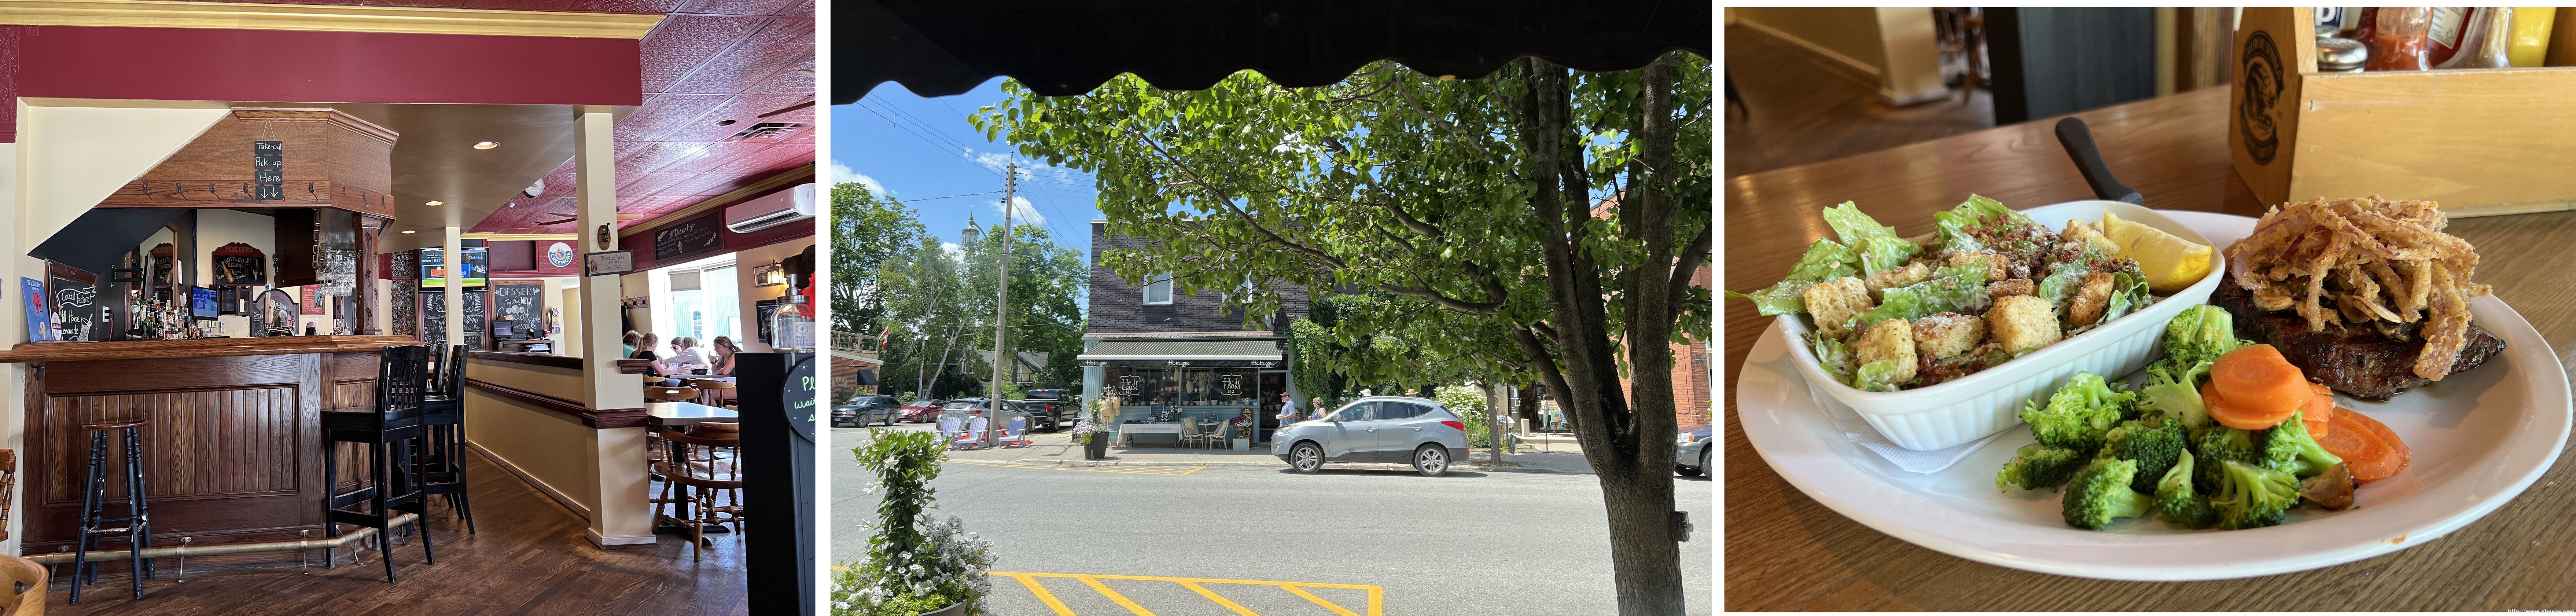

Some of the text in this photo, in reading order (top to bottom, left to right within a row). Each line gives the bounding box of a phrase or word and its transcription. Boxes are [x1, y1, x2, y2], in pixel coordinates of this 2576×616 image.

[255, 157, 268, 166] Pick
[259, 172, 281, 182] Here
[674, 223, 689, 236] Dessert
[550, 252, 571, 265] CREEMORE
[500, 287, 536, 296] DESSERT
[62, 291, 89, 304] Cocktail Feature
[520, 297, 532, 305] NEW
[68, 310, 80, 323] House
[808, 414, 816, 422] s
